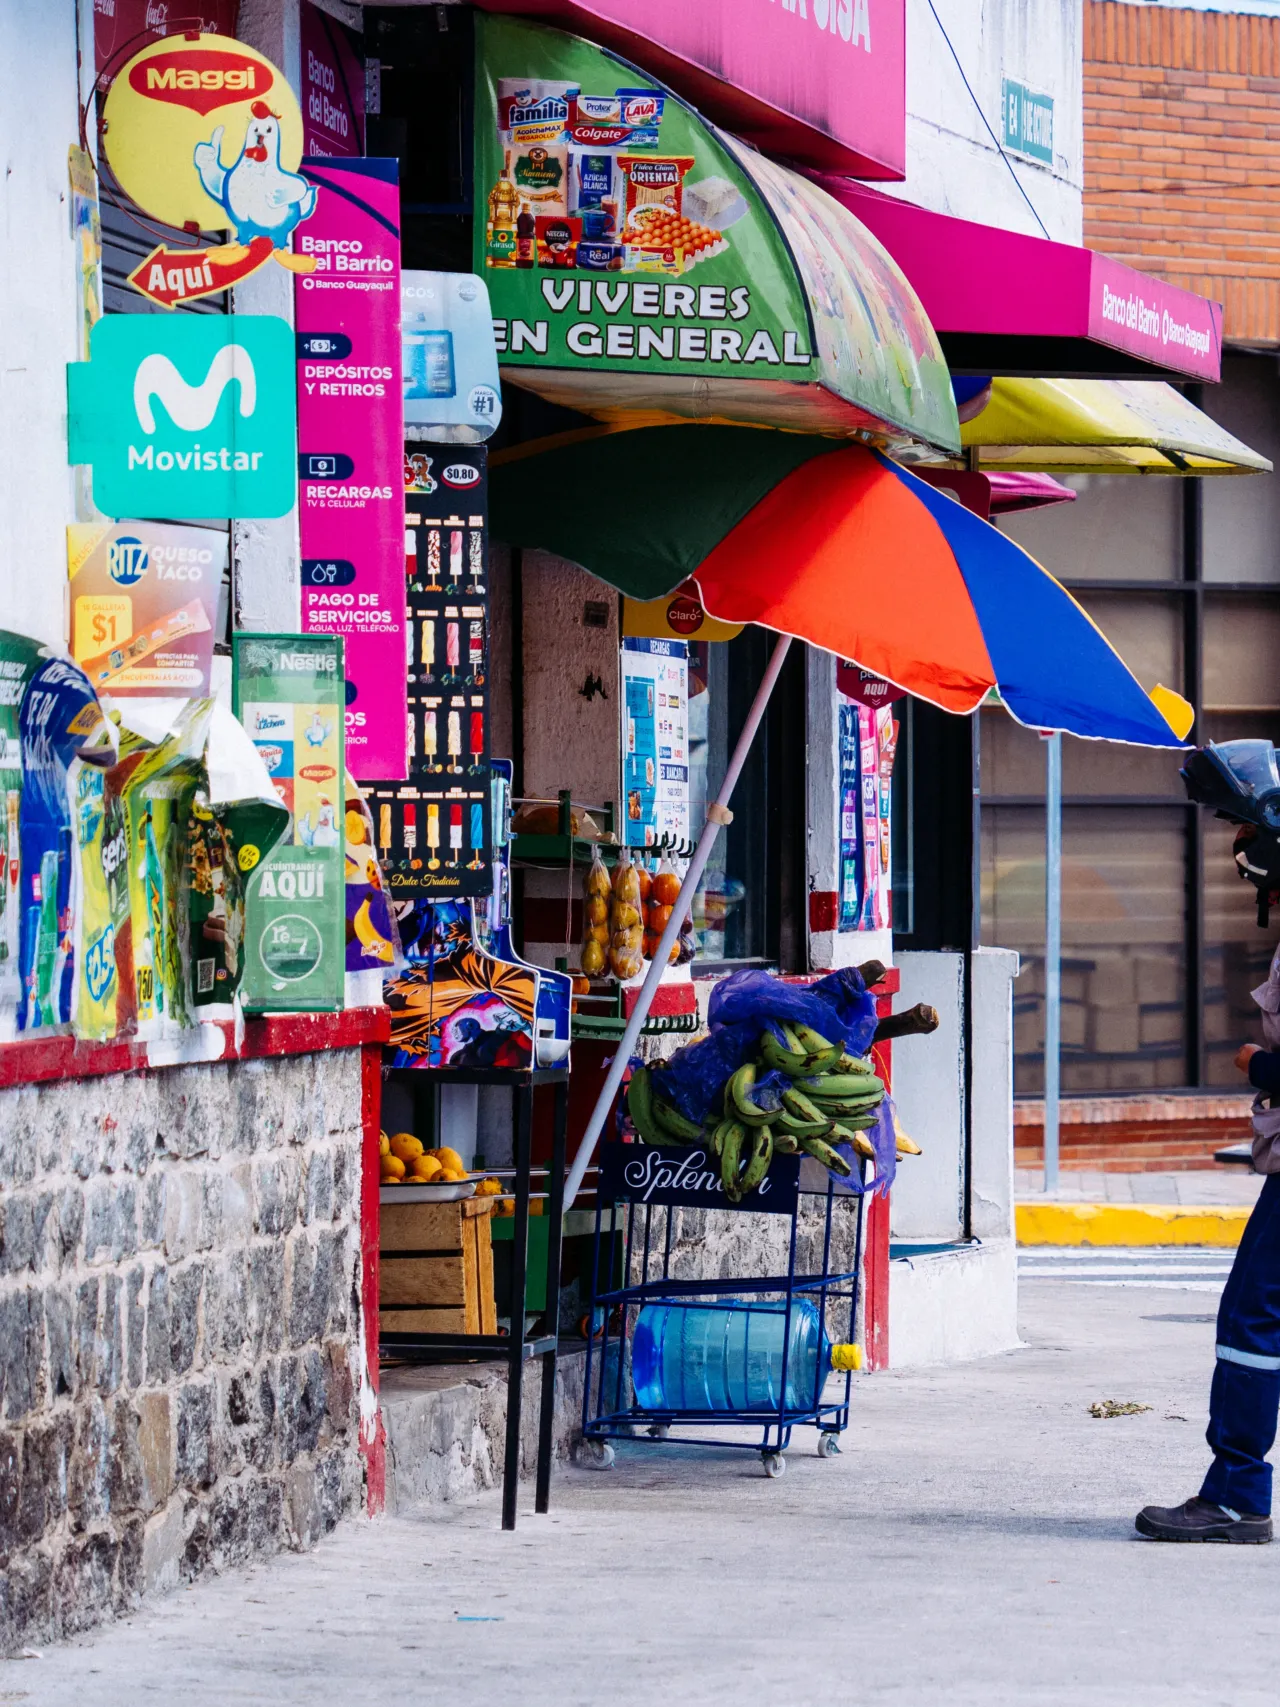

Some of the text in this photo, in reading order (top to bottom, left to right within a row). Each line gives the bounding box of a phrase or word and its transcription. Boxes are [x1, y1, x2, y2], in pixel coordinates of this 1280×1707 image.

[147, 66, 255, 90] Maggi
[308, 50, 334, 93] Banco
[309, 87, 348, 137] del Barrio
[509, 101, 568, 122] familia
[626, 103, 655, 117] LAVA
[574, 127, 622, 140] Colgate
[630, 171, 680, 183] ORIENTAL
[583, 181, 608, 190] BLANCA
[302, 236, 363, 254] Banco
[309, 254, 394, 272] el Barrio
[148, 256, 214, 296] Aquí
[315, 280, 394, 292] Banco Guayaquil
[542, 278, 750, 320] VIVERES
[1102, 284, 1160, 338] Banco del Barrio
[566, 321, 811, 366] GENERAL
[304, 364, 393, 379] DEPÓSITOS
[304, 383, 386, 396] Y RETIROS
[473, 397, 495, 413] #1
[128, 444, 264, 471] Movistar
[446, 468, 474, 480] $0,80
[306, 485, 393, 499] RECARGAS
[306, 500, 318, 508] TV
[327, 500, 366, 508] CELULAR
[107, 543, 213, 579] RITZ QUESO
[156, 564, 203, 581] TACO
[308, 593, 379, 606] PAGO DE
[308, 610, 392, 623] SERVICIOS
[668, 610, 697, 621] Claro
[92, 614, 117, 647] $1
[355, 623, 400, 633] TELÉFONO
[863, 684, 888, 696] AQUÍ
[258, 864, 324, 900] AQUÍ
